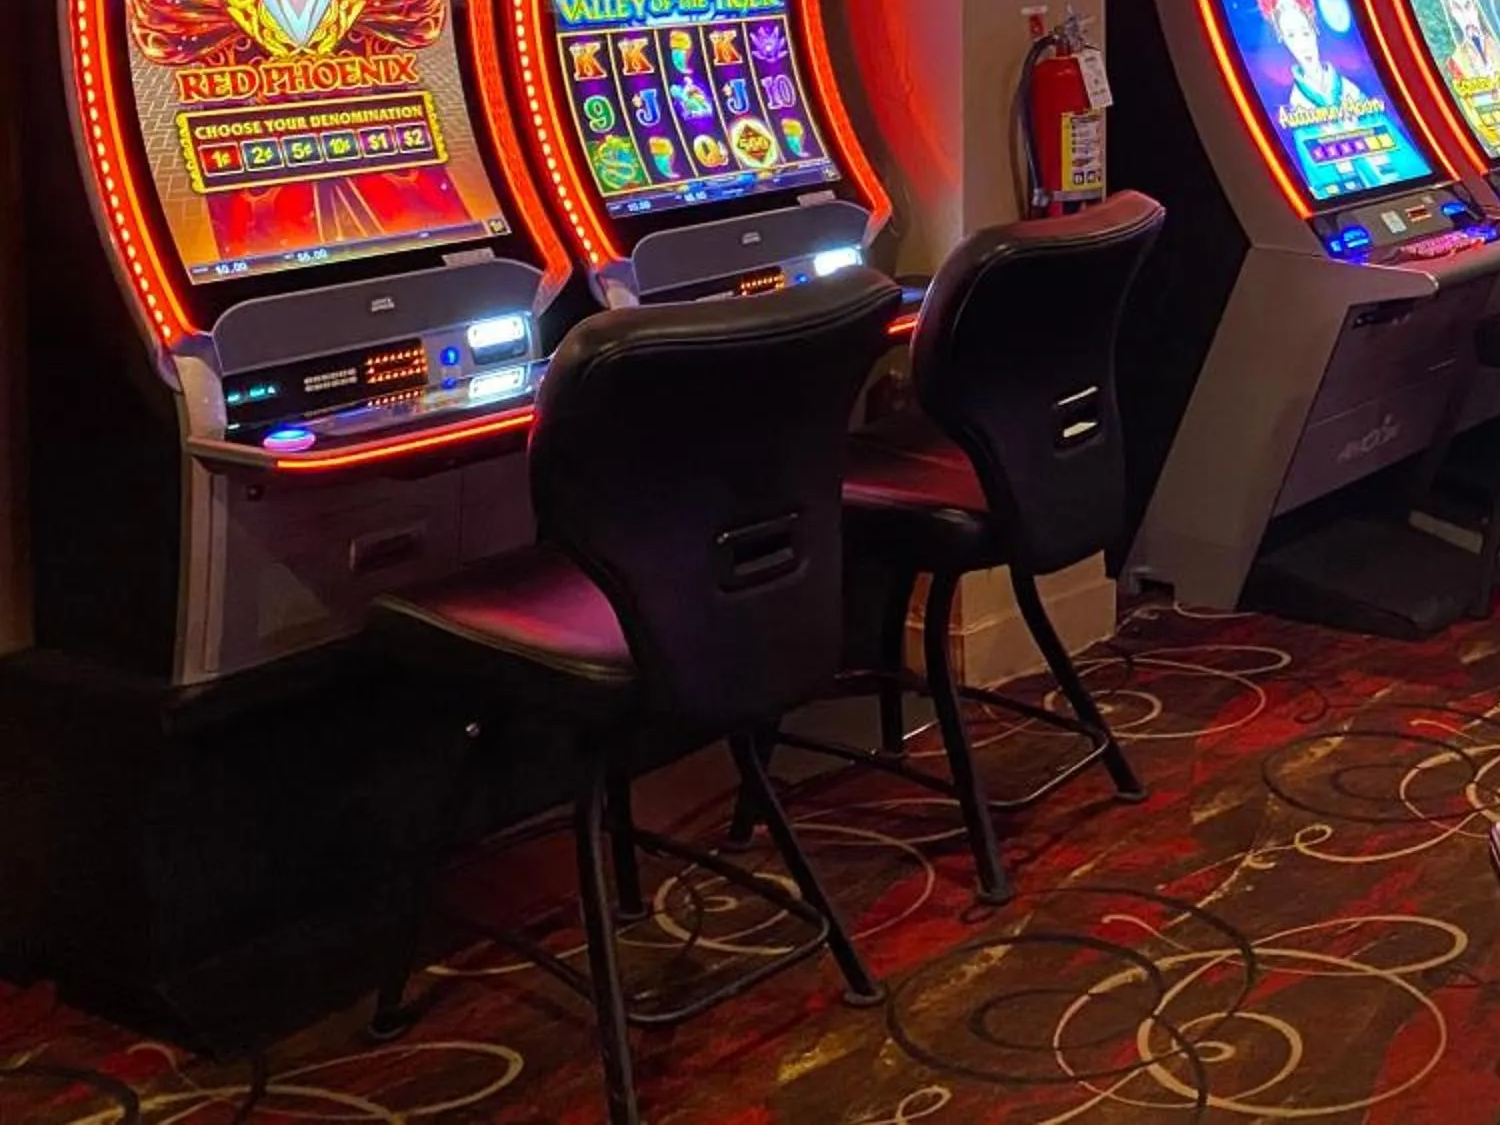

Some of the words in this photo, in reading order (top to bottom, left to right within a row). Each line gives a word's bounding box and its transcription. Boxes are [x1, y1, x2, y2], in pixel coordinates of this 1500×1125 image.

[177, 66, 259, 104] RED
[261, 54, 420, 96] PHOENIX
[195, 118, 262, 140] CHOOSE
[266, 114, 307, 133] YOUR
[310, 105, 424, 128] DENOMINATION
[369, 132, 388, 151] $1
[403, 129, 425, 147] $2
